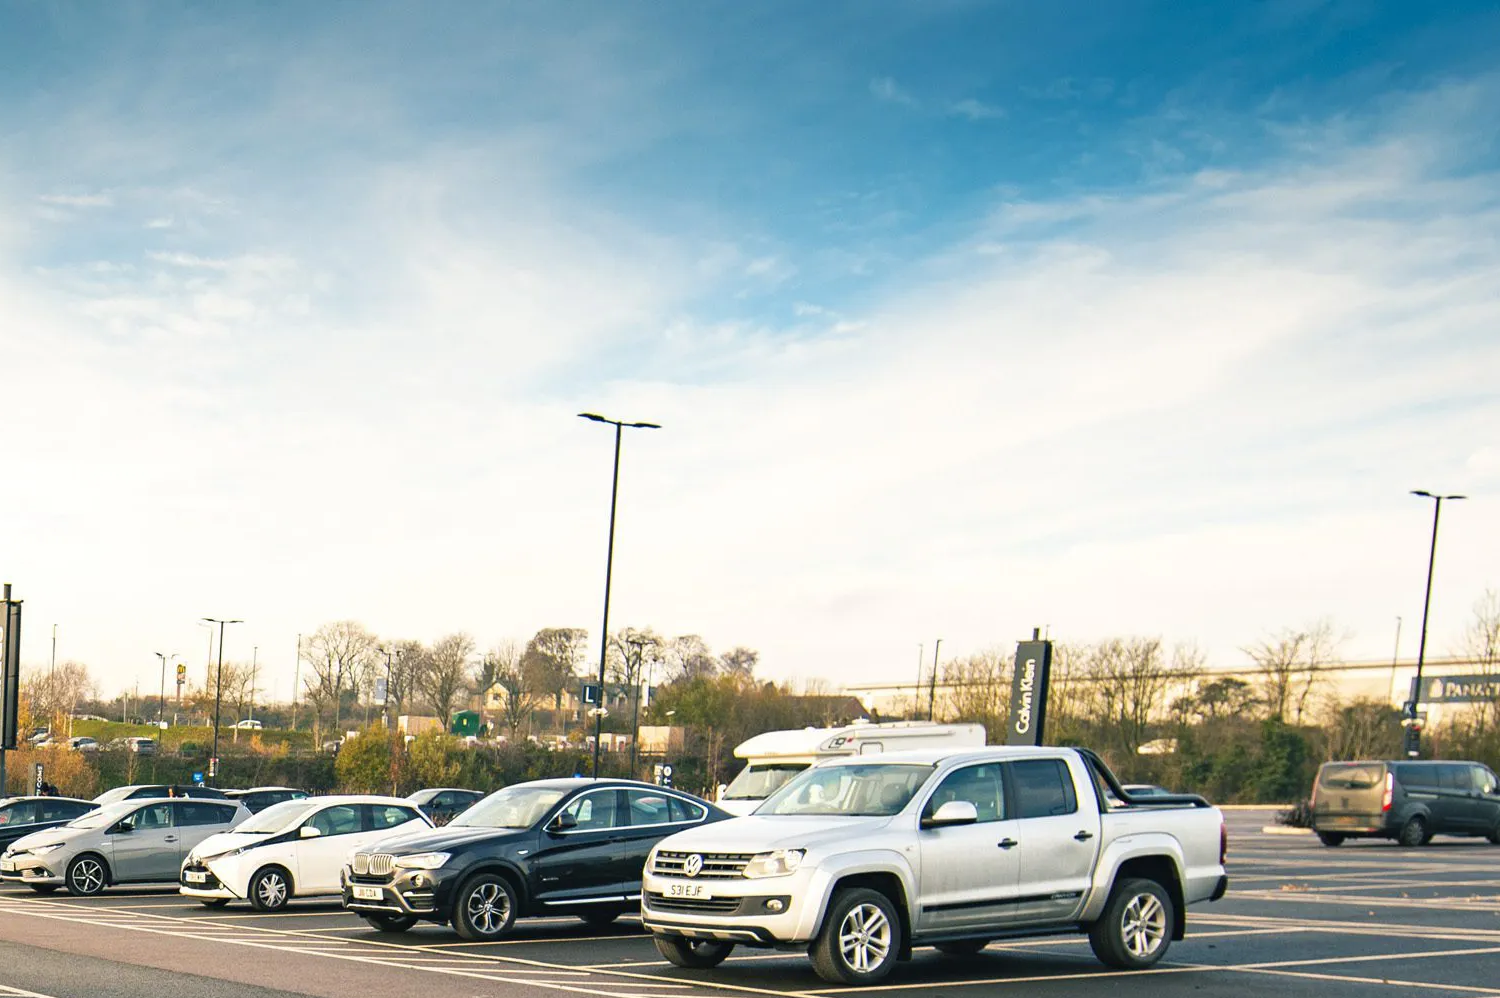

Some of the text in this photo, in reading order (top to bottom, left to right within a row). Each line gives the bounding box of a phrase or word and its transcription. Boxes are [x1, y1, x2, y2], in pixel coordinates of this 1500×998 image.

[585, 686, 594, 702] L
[1015, 658, 1036, 734] Calvin Klein
[685, 885, 703, 896] EJF
